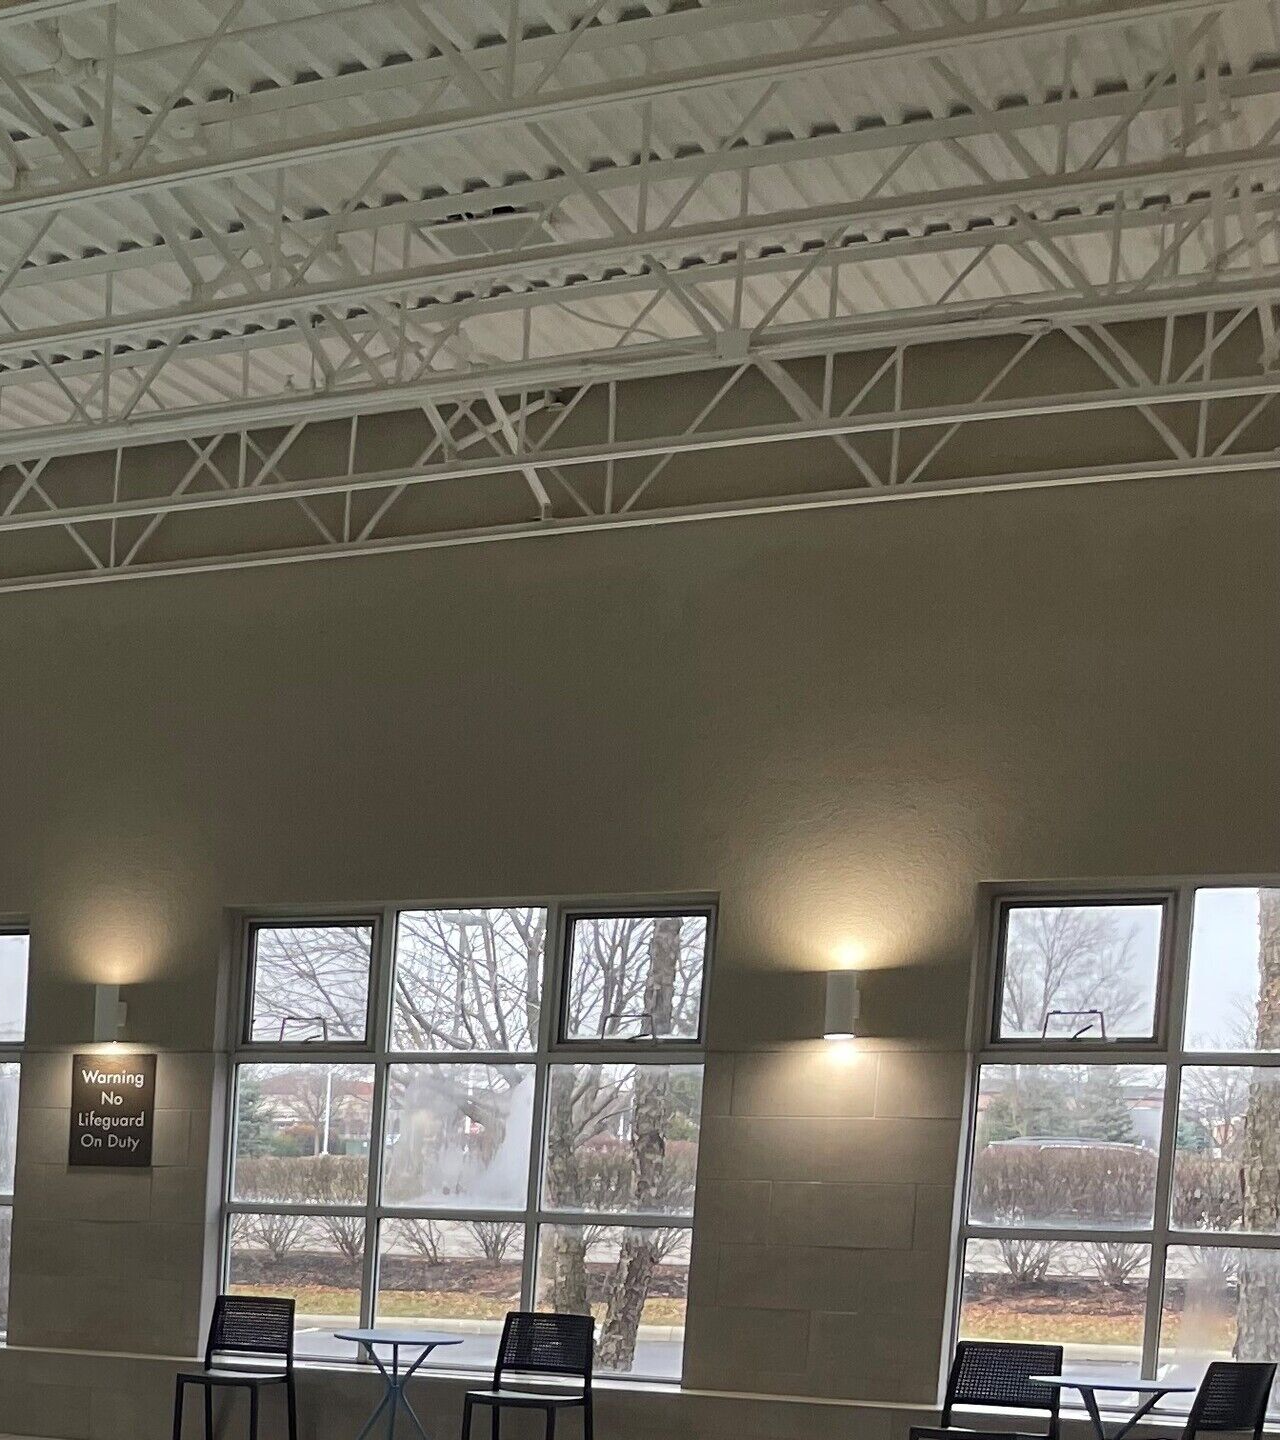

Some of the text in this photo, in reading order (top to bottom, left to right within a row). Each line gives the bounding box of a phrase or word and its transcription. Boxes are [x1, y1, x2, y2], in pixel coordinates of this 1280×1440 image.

[81, 1068, 145, 1089] Warning
[101, 1090, 124, 1106] No
[77, 1110, 145, 1131] Lifeguard
[80, 1133, 140, 1152] On Duty
